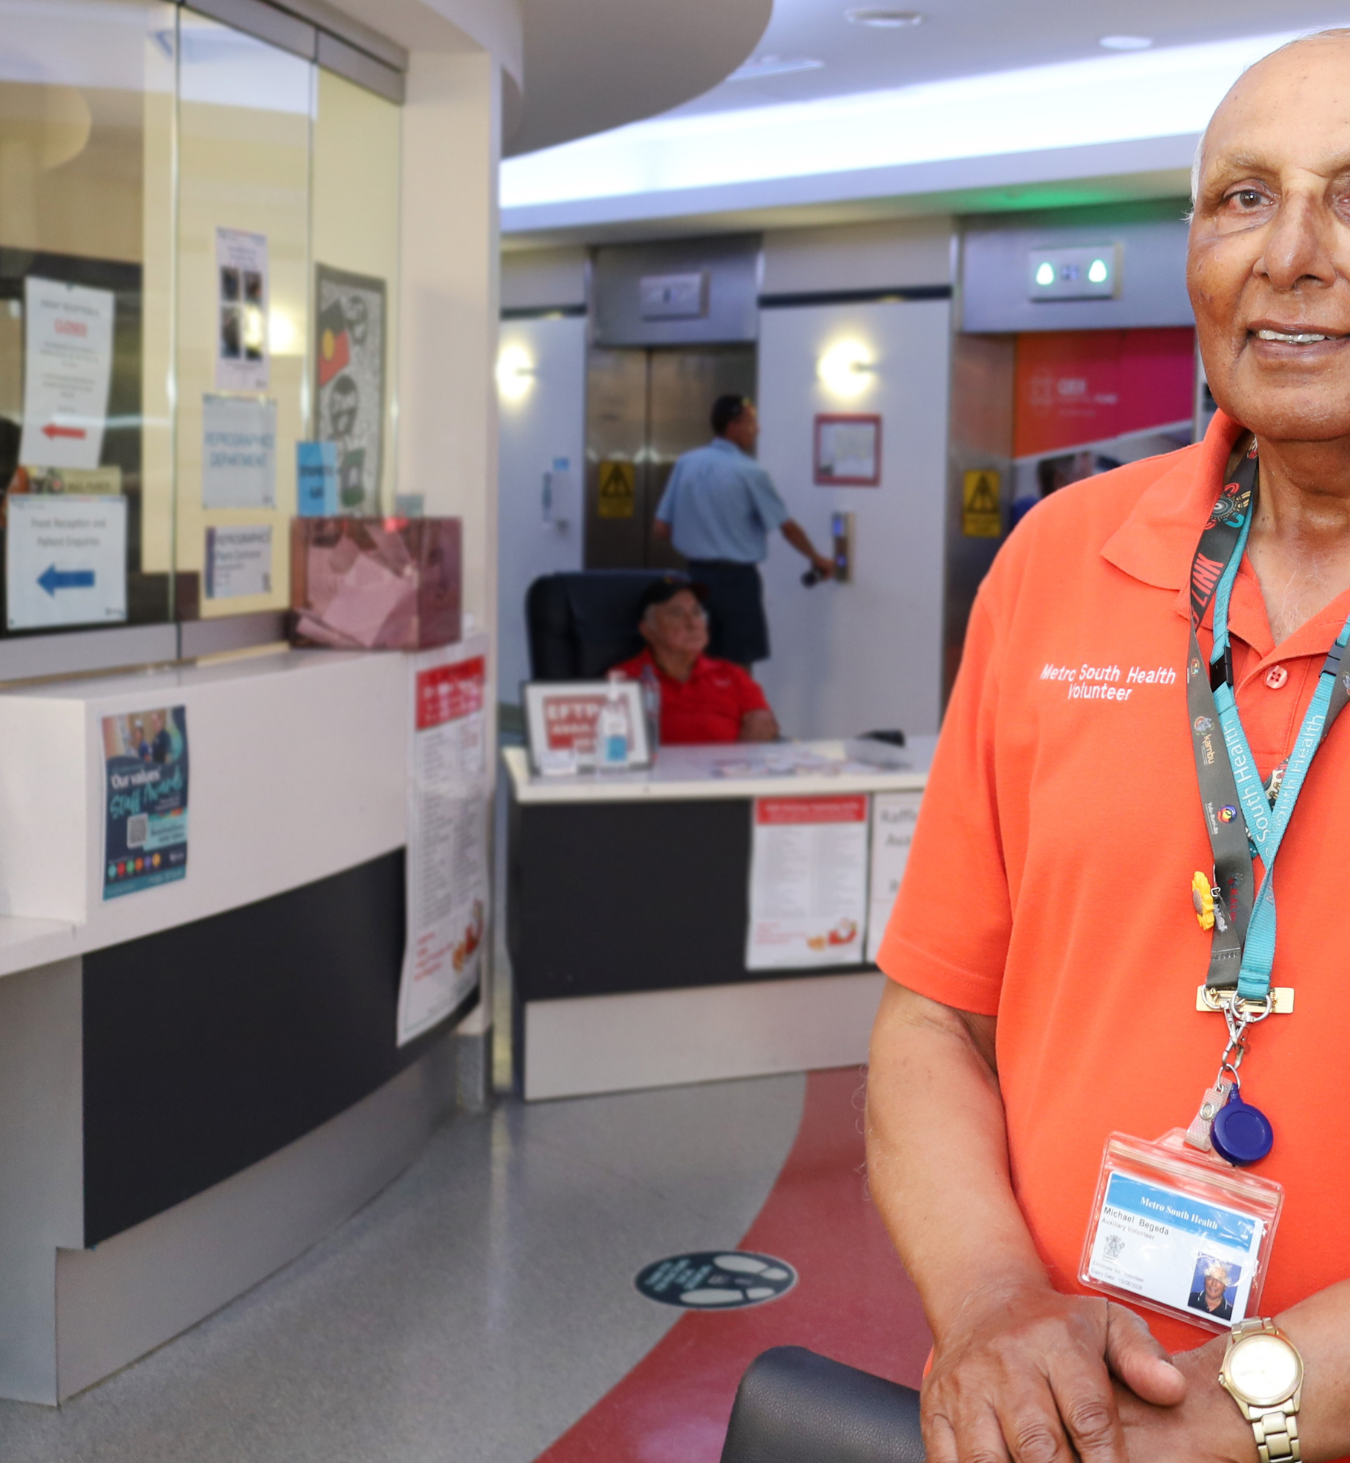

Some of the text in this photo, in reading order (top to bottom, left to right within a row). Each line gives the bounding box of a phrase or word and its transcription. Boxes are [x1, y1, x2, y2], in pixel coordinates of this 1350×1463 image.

[204, 432, 274, 450] REPROGRAPHICS
[210, 452, 267, 468] DEPARTMENT
[1040, 663, 1077, 681] Metro
[1078, 663, 1121, 682] South
[1126, 666, 1176, 684] Health
[1067, 682, 1132, 700] Volunteer
[1202, 734, 1215, 765] kambu
[1290, 714, 1326, 773] Health
[1223, 719, 1270, 843] South Health
[109, 788, 140, 821] Staff
[1229, 888, 1238, 924] KALW
[1103, 1206, 1170, 1237] Michael Begeda
[1140, 1196, 1218, 1230] Metro South Health
[1101, 1217, 1155, 1241] Auxiliary Volunteer
